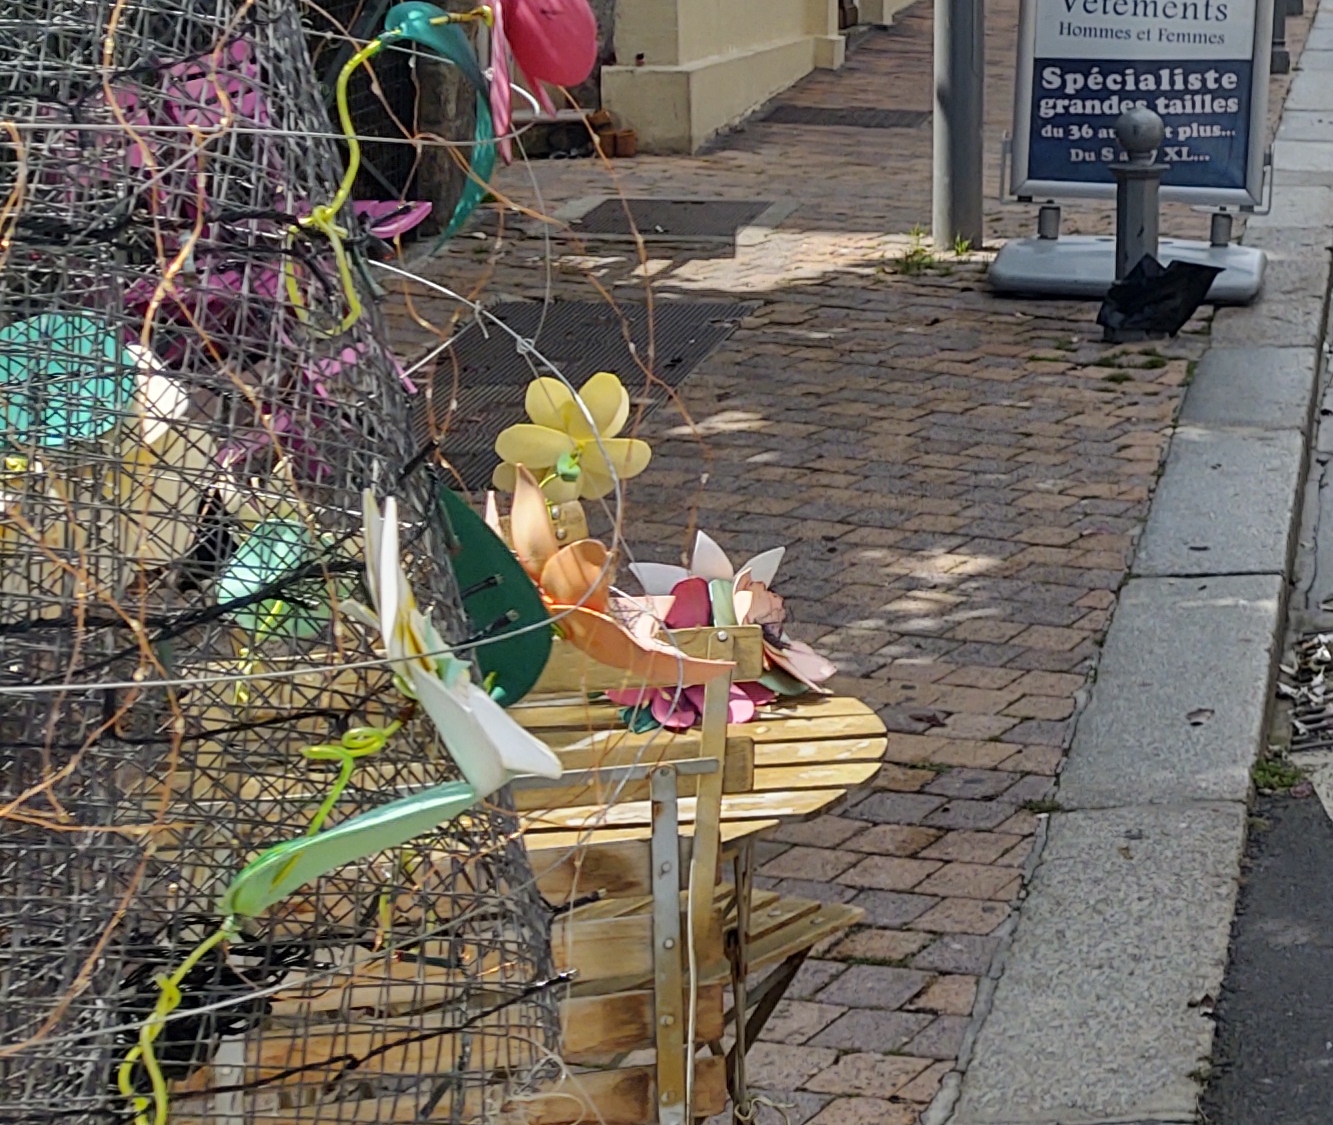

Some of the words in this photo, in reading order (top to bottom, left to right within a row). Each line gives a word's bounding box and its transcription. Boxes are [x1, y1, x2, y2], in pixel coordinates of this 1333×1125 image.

[1059, 21, 1131, 41] Hommes
[1137, 26, 1151, 41] et
[1158, 27, 1225, 45] Femmes
[1042, 67, 1238, 94] Spécialiste
[1155, 94, 1239, 114] tailles
[1041, 124, 1064, 138] du
[1068, 124, 1094, 139] 36
[1164, 124, 1173, 138] t
[1070, 148, 1097, 161] Du
[1101, 147, 1114, 161] S
[1119, 150, 1129, 161] a
